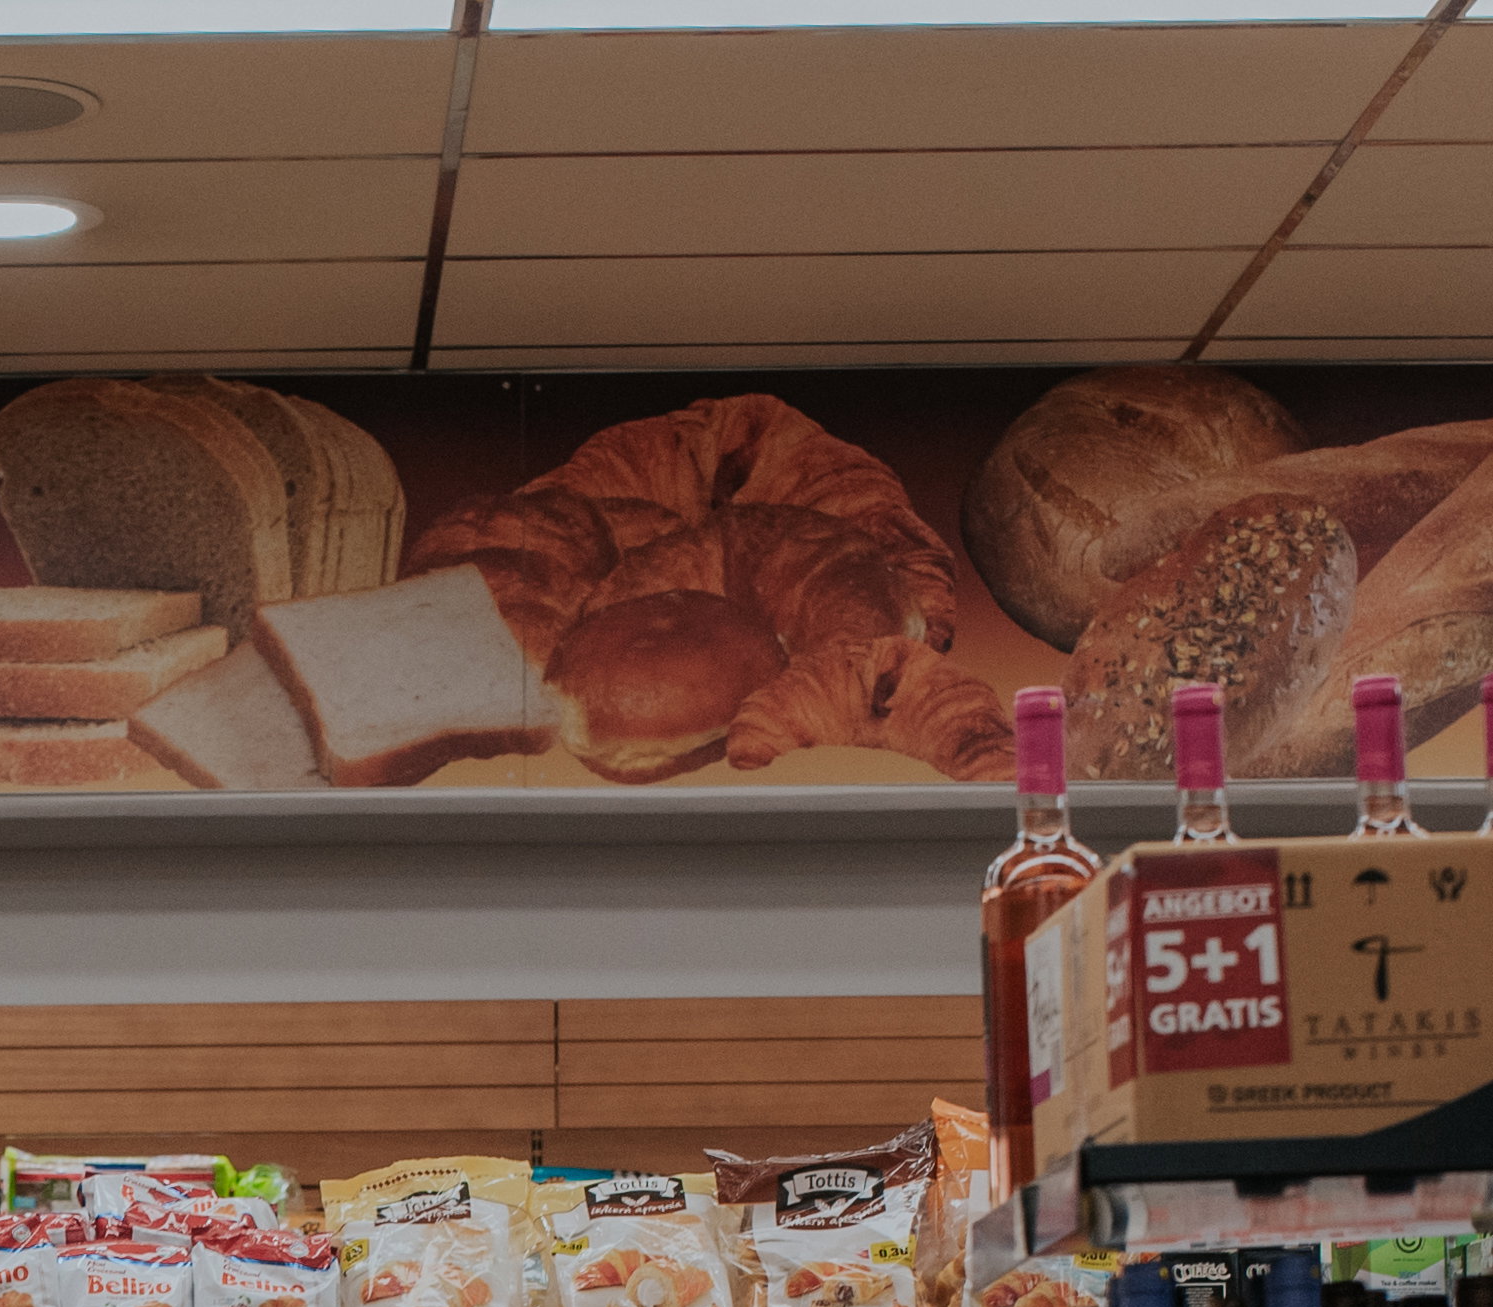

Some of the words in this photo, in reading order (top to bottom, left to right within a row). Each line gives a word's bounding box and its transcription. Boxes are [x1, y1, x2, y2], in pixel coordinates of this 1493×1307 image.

[1143, 886, 1273, 920] ANGEBOT
[1144, 923, 1281, 994] 5+1
[1149, 996, 1283, 1036] GRATIS
[804, 1170, 857, 1192] Tottis
[86, 1274, 173, 1296] Belino
